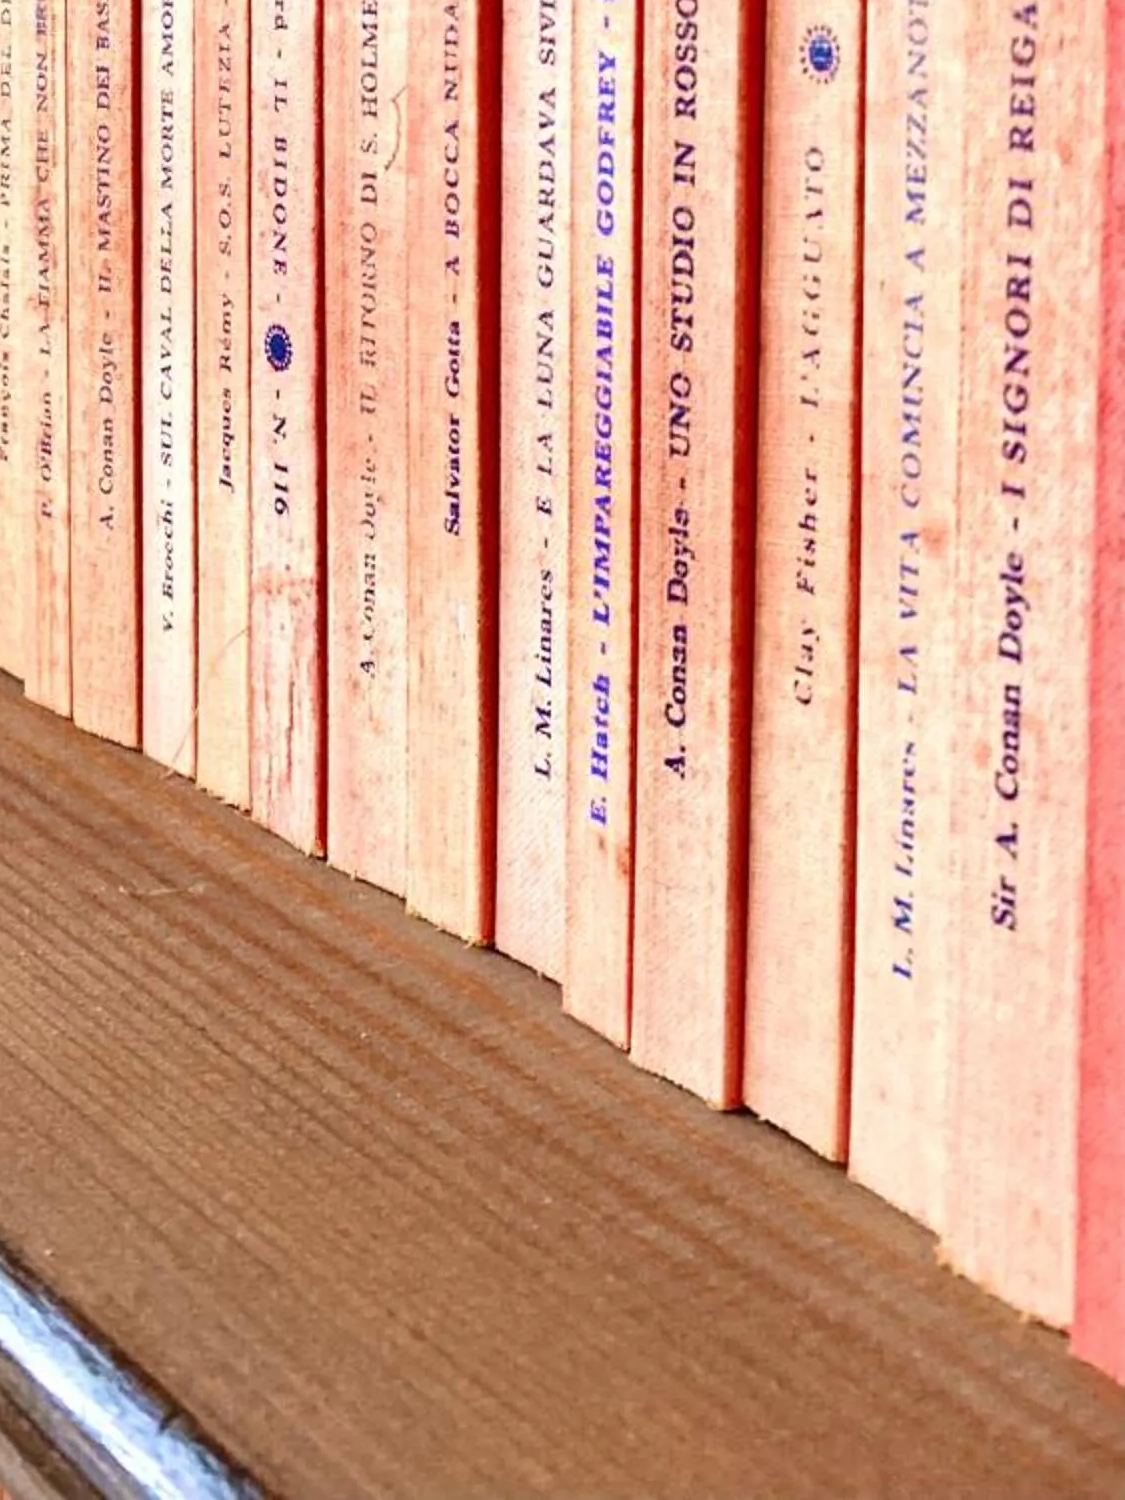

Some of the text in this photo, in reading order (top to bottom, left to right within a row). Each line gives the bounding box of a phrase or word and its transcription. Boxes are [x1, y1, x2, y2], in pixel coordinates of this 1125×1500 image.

[95, 65, 110, 111] DEI
[217, 22, 232, 159] LUTEZIA
[443, 2, 459, 102] NUDA
[273, 76, 288, 112] IL
[160, 89, 174, 191] MORTE
[444, 119, 460, 239] BOCCA
[596, 50, 616, 237] GODFREY
[673, 139, 696, 187] IN
[96, 124, 111, 252] MASTINO
[218, 174, 232, 257] S.O.S.
[272, 135, 288, 276] BIDONE
[536, 87, 557, 289] GUARDAVA
[1006, 177, 1035, 229] DI
[97, 265, 112, 294] IL
[160, 202, 173, 295] DELLA
[444, 256, 460, 276] A
[670, 205, 696, 353] STUDIO
[904, 247, 926, 273] A
[99, 331, 117, 405] Doyle
[160, 306, 173, 401] CAVAL
[218, 292, 234, 372] Rémy
[444, 319, 461, 398] Gotta
[536, 309, 554, 409] LUNA
[1001, 252, 1033, 464] SIGNORI
[160, 412, 172, 467] SUL
[219, 386, 235, 493] Jacques
[272, 411, 287, 444] N.
[593, 253, 614, 626] L'IMPAREGGIABILE
[668, 372, 692, 458] UNO
[900, 293, 925, 510] COMINCIA
[98, 417, 113, 496] Conan
[273, 461, 289, 516] 116
[444, 411, 461, 536] Salvator
[536, 432, 553, 476] LA
[1000, 479, 1026, 499] I
[99, 505, 114, 531] A.
[535, 495, 553, 516] E
[796, 466, 818, 596] Fisher
[666, 506, 696, 606] Doyle
[898, 530, 920, 620] VITA
[162, 609, 174, 633] V.
[535, 568, 554, 687] Linares
[997, 551, 1031, 664] Doyle
[664, 623, 688, 728] Conan
[793, 619, 821, 706] Clay
[897, 644, 918, 696] LA
[534, 699, 552, 739] M.
[590, 673, 610, 780] Hatch
[994, 682, 1022, 801] Conan
[534, 751, 552, 781] L.
[663, 745, 686, 779] A.
[590, 796, 607, 826] E.
[893, 740, 916, 878] Linares
[994, 821, 1019, 859] A.
[893, 890, 913, 936] M.
[990, 875, 1018, 933] Sir
[891, 947, 913, 980] L.
